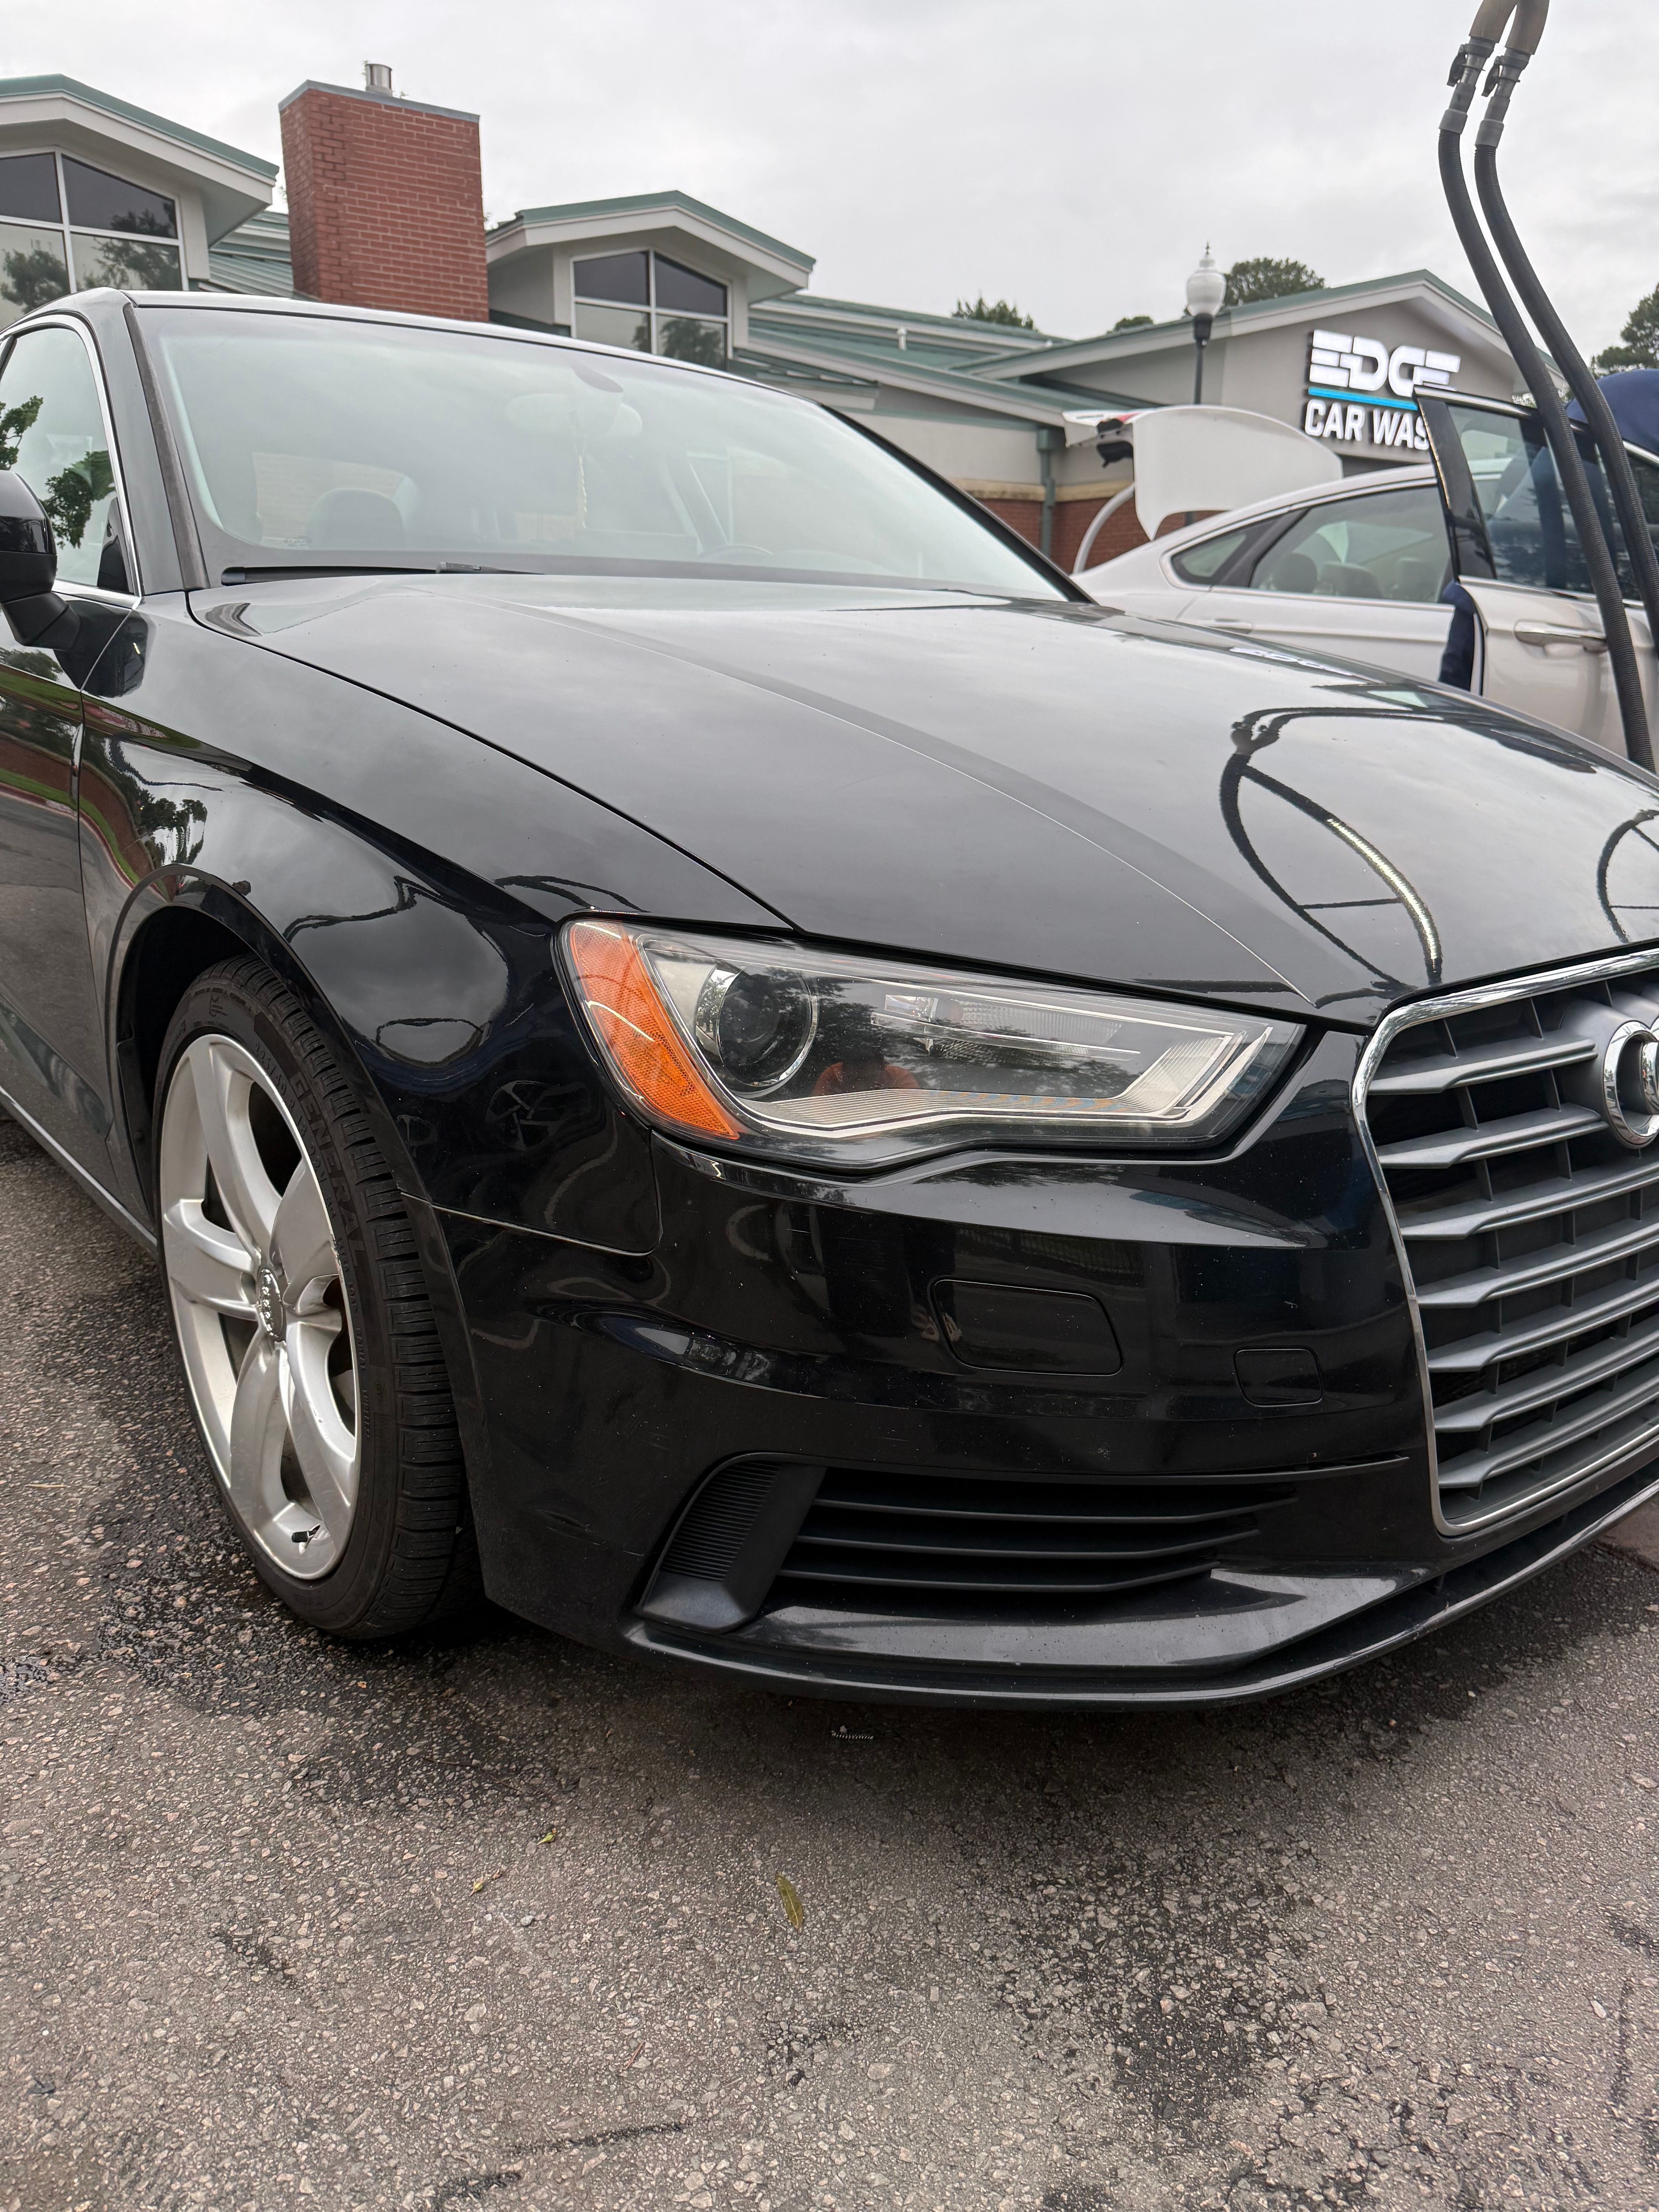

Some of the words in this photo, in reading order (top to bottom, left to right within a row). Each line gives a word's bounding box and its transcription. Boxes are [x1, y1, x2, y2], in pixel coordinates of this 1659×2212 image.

[1309, 329, 1461, 397] EDGE
[1304, 399, 1365, 442] CAR
[1373, 409, 1430, 451] WAS
[290, 1072, 366, 1267] GENERAL
